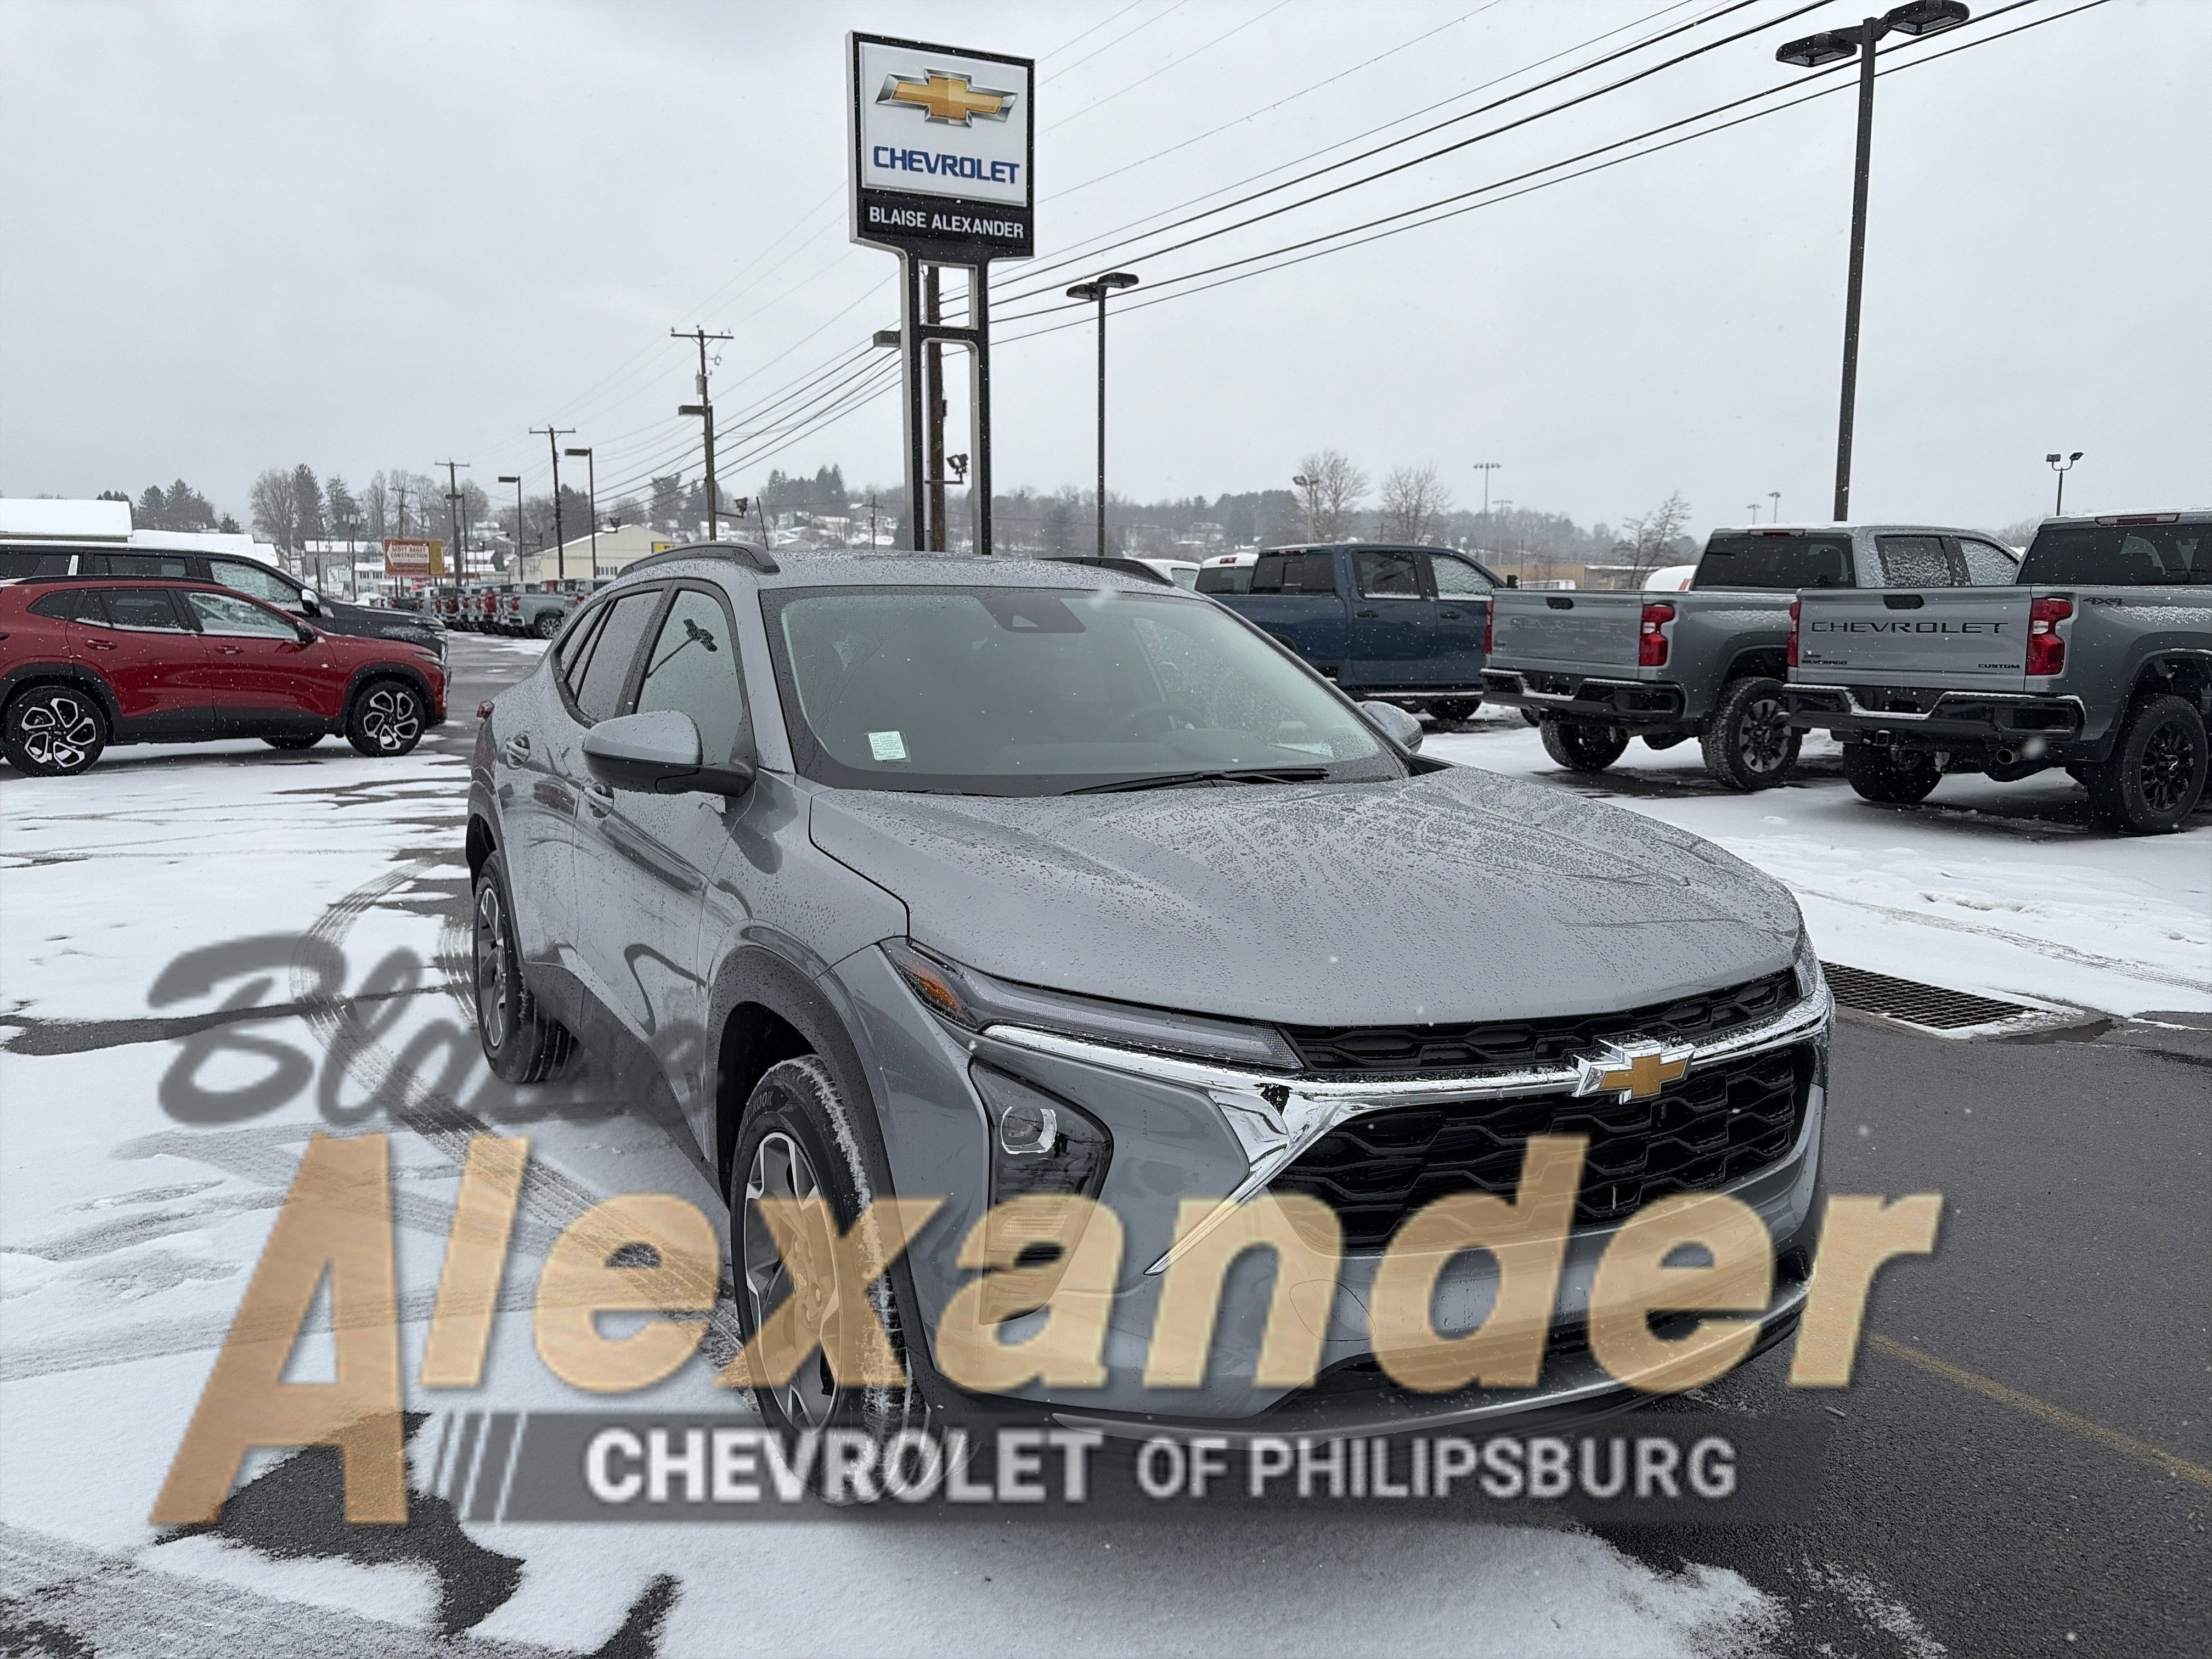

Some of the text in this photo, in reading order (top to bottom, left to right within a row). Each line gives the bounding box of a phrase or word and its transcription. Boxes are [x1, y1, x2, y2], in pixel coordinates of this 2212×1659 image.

[873, 145, 1020, 184] CHEVROLET
[869, 206, 1024, 239] BLAISE ALEXANDER
[1812, 622, 2009, 634] CHEVROLET
